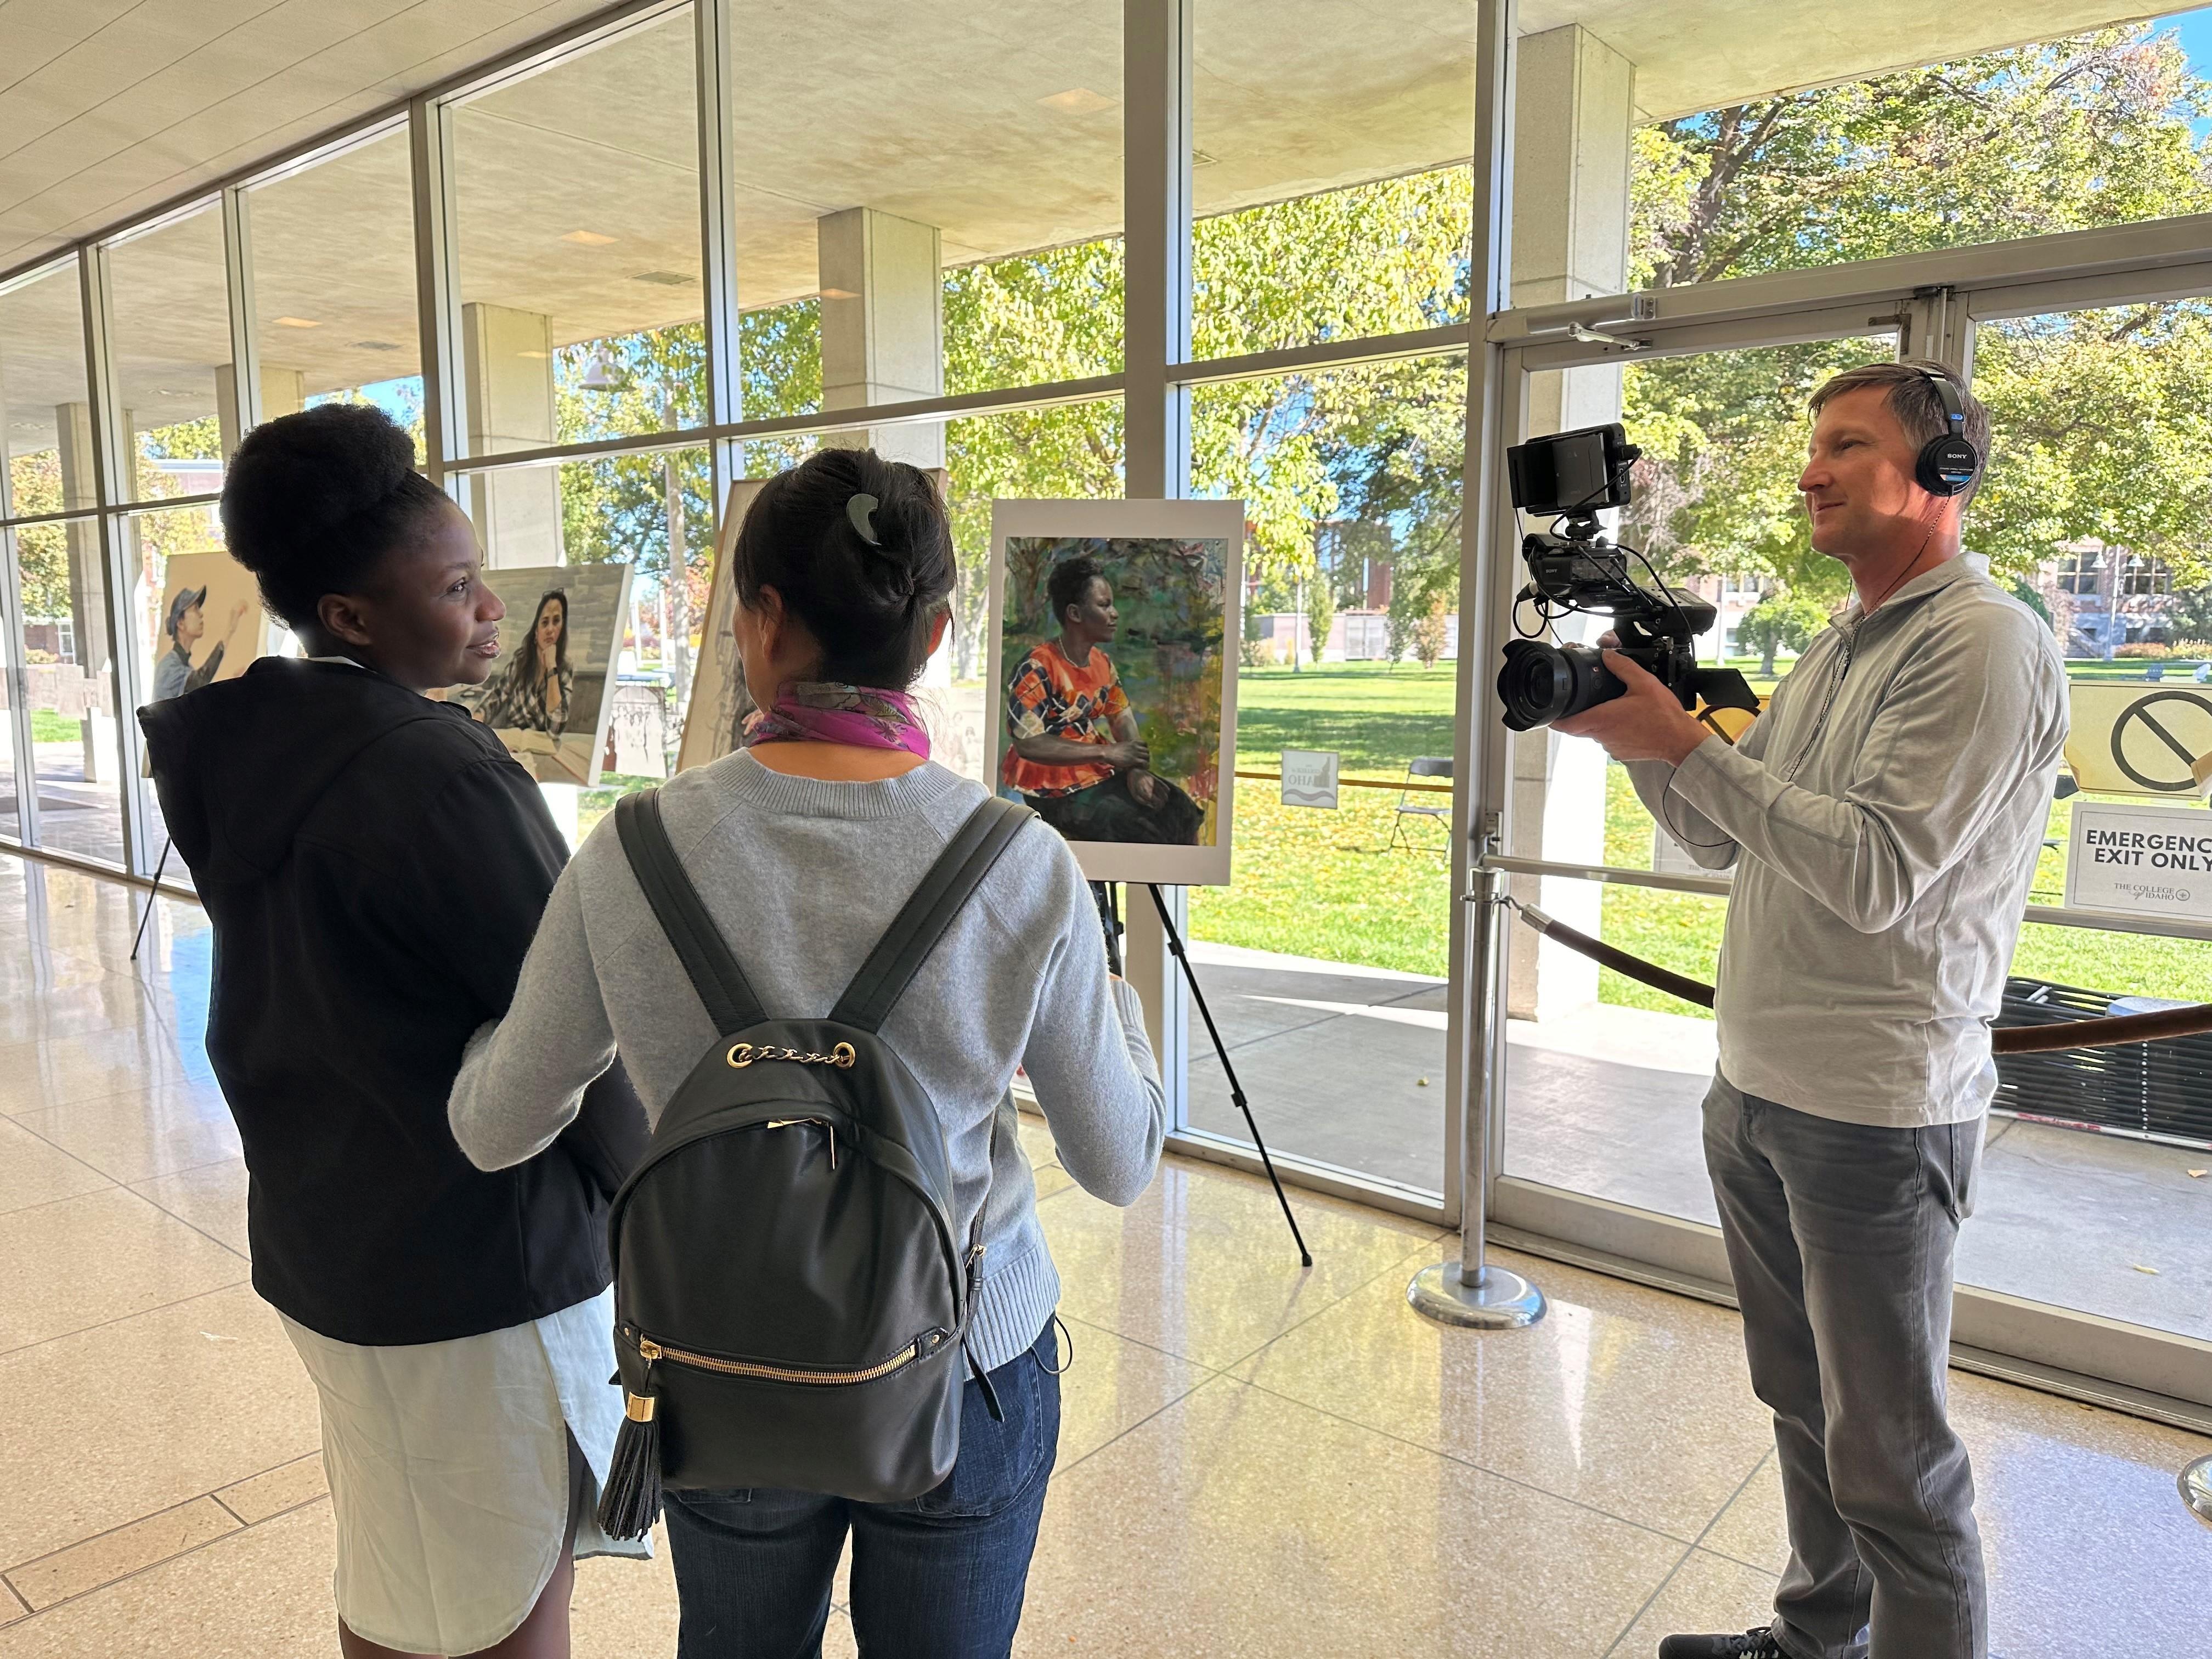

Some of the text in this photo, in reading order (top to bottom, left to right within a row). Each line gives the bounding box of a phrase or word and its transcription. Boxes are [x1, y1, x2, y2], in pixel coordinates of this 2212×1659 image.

[2086, 830, 2212, 853] EMERGENC
[2095, 848, 2212, 872] EXIT ONLY
[2134, 884, 2175, 894] COLLEGE
[2146, 892, 2174, 900] IDAHO
